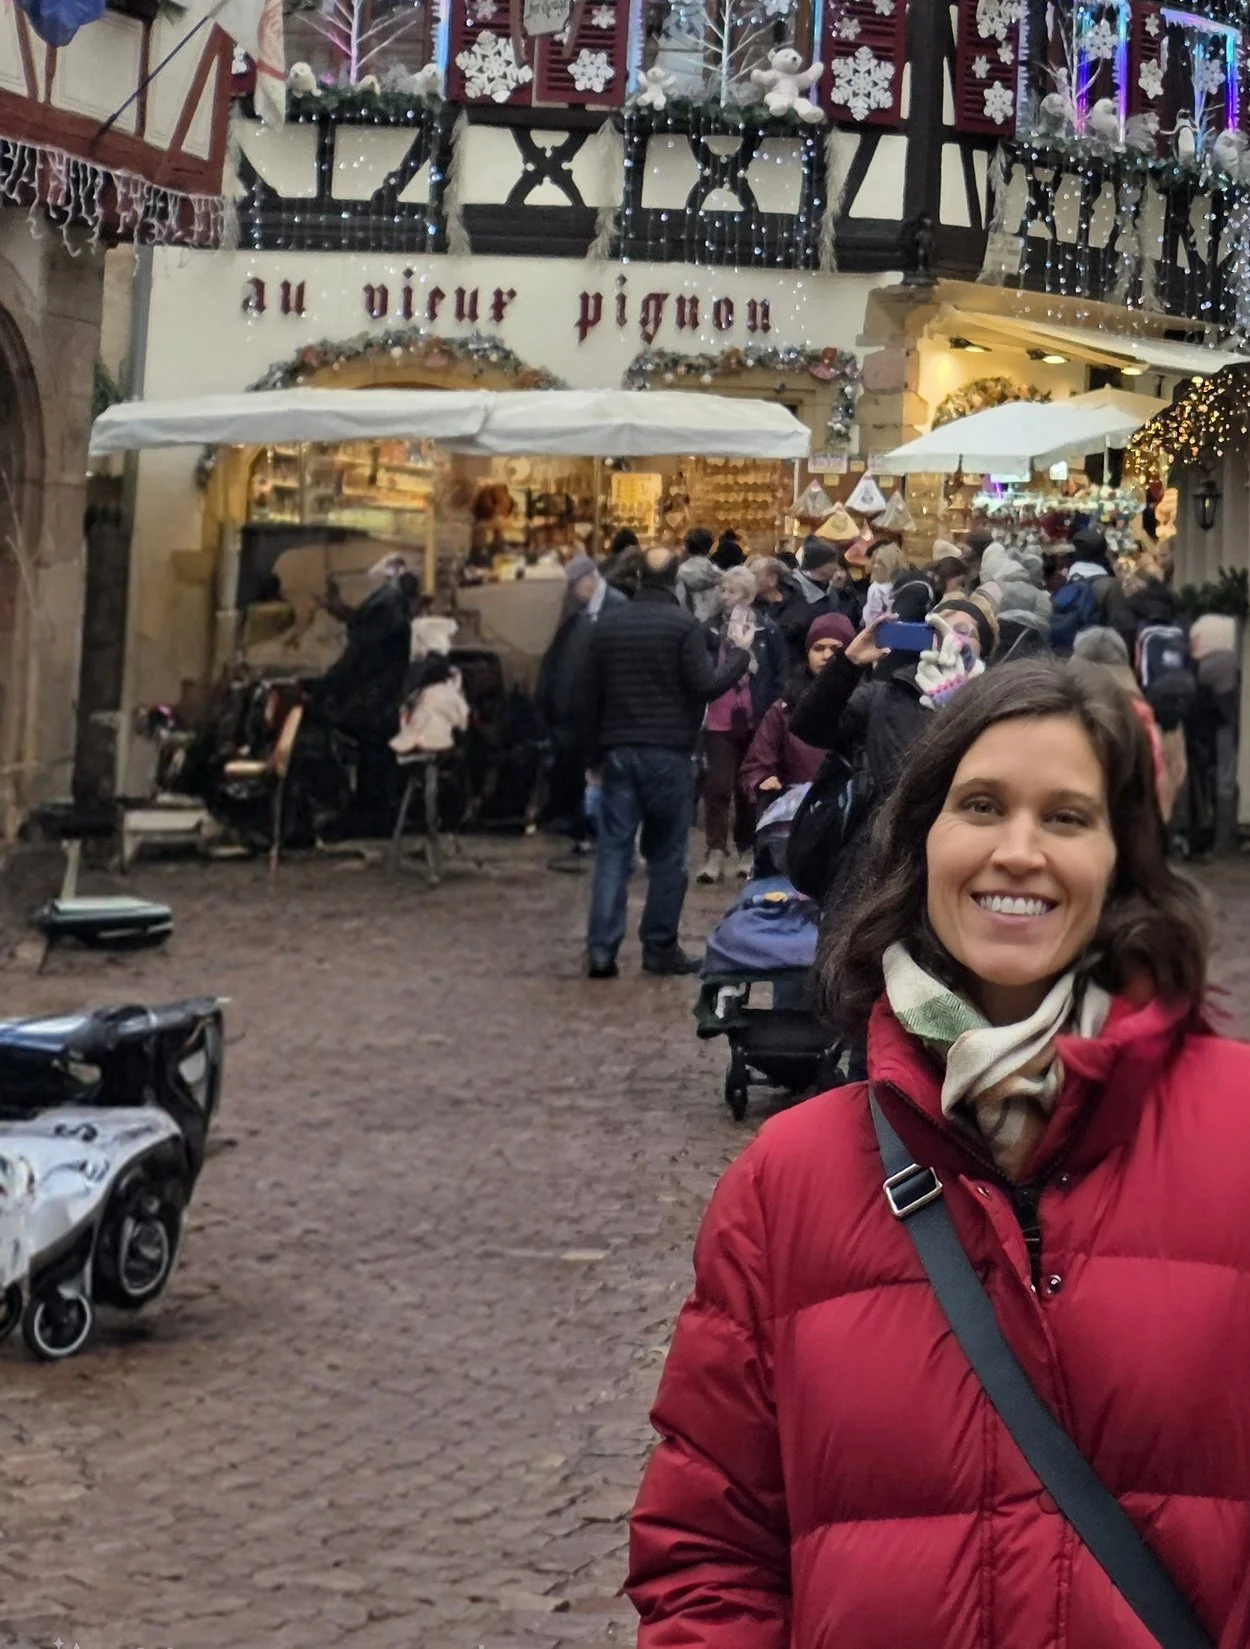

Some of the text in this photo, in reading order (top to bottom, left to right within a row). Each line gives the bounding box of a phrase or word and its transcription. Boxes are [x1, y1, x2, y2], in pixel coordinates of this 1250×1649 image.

[241, 267, 771, 346] au vieux pignon
